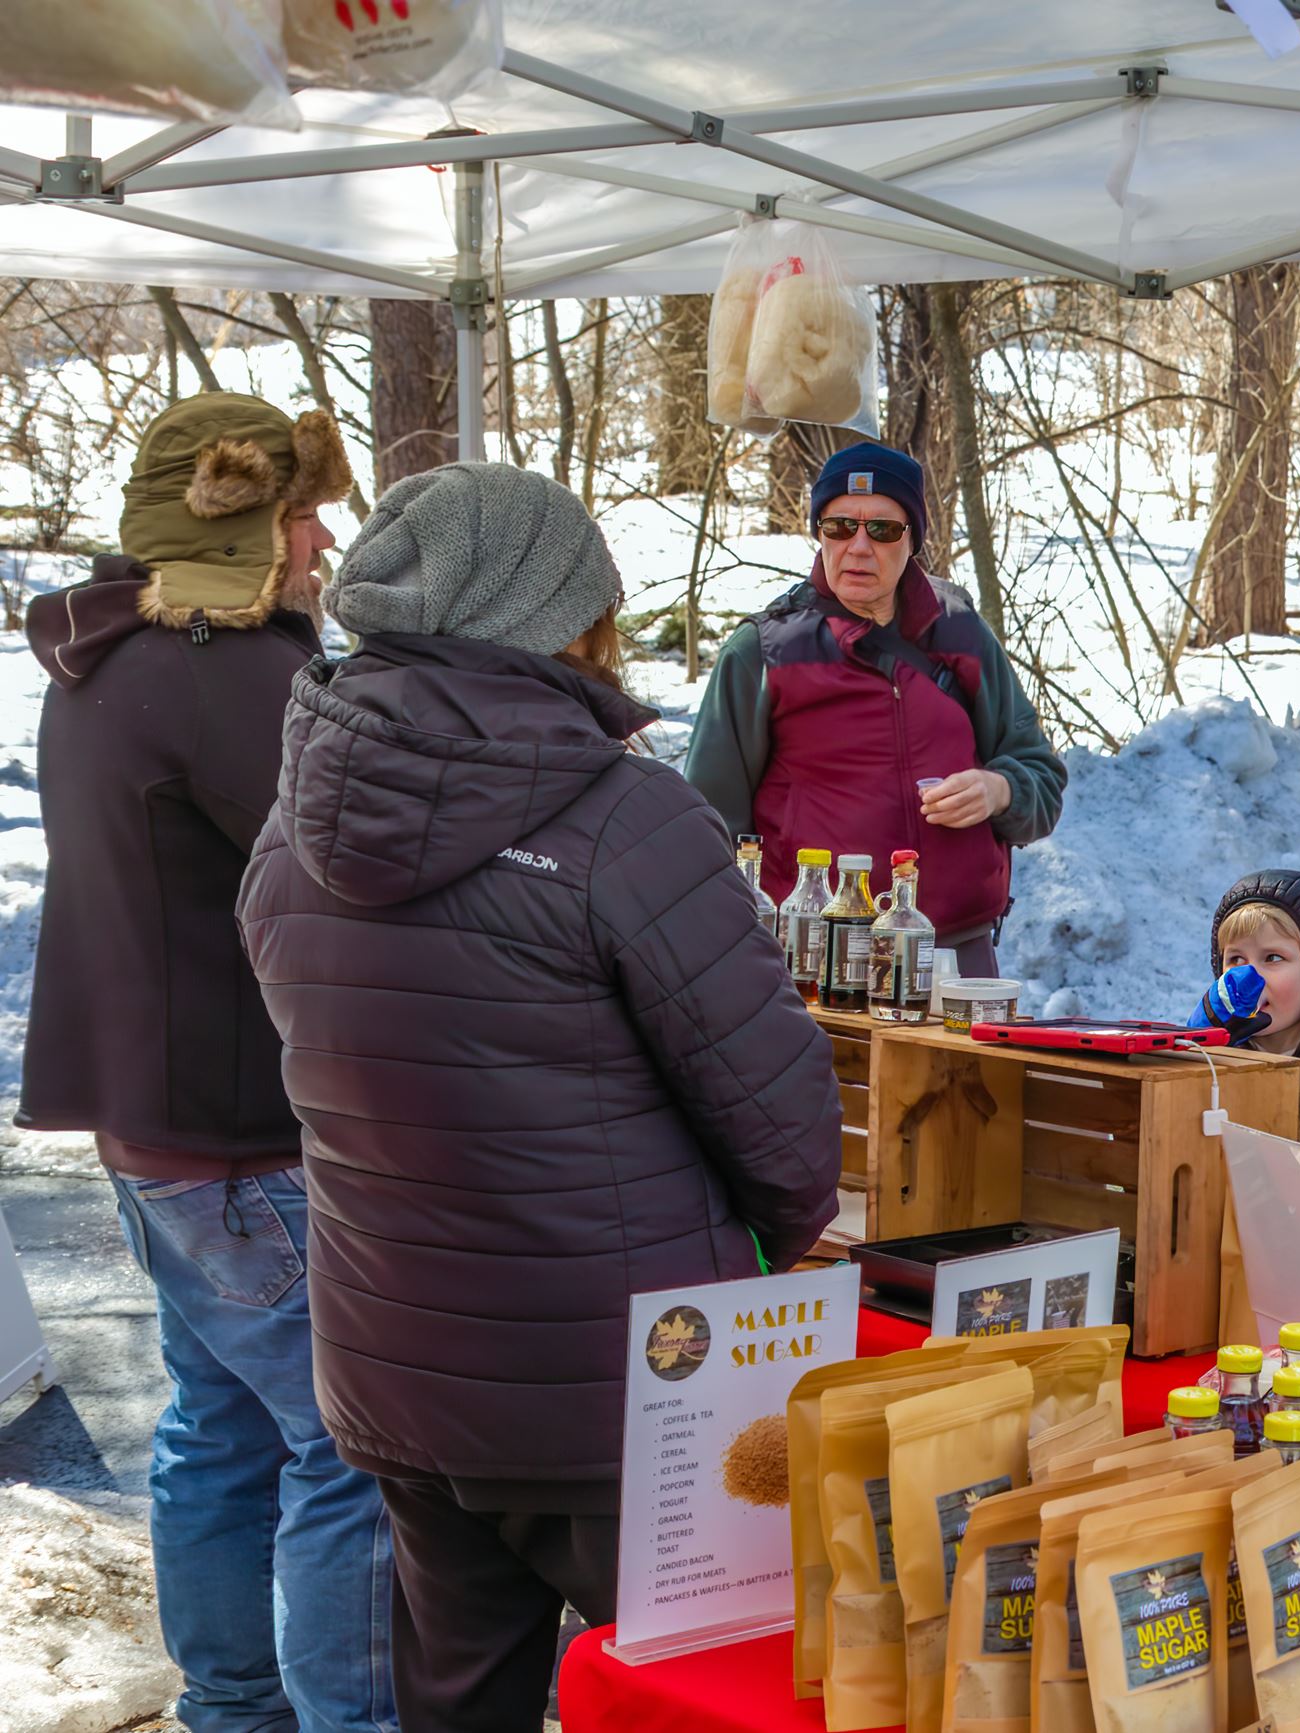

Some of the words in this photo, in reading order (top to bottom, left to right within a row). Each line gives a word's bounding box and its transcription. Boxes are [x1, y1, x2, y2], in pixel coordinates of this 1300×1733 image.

[498, 848, 558, 872] ARBON
[731, 1298, 830, 1334] MAPLE
[730, 1334, 822, 1368] SUGAR
[643, 1401, 666, 1412] GREAT
[662, 1414, 689, 1426] COFFEE
[691, 1412, 697, 1421] &
[700, 1410, 714, 1419] TEA
[661, 1430, 696, 1442] OATMEAL
[661, 1448, 687, 1459] CEREAL
[660, 1467, 671, 1475] ICE
[673, 1462, 699, 1473] CREAM
[660, 1480, 695, 1492] POPCORN
[659, 1496, 688, 1508] YOGURT
[658, 1512, 693, 1525] GRANOLA
[657, 1528, 695, 1542] BUTTERED
[656, 1544, 680, 1556] TOAST
[656, 1559, 688, 1573] CANDIED
[689, 1554, 714, 1566] BACON
[655, 1580, 670, 1589] DRY
[671, 1577, 686, 1586] RUB
[687, 1573, 701, 1583] FOR
[703, 1567, 727, 1579] MEATS
[654, 1590, 691, 1606] PANCAKES
[692, 1589, 697, 1598] &
[746, 1571, 771, 1586] BATTER
[772, 1571, 783, 1580] OR
[783, 1569, 790, 1578] A
[1136, 1607, 1204, 1647] MAPLE
[1139, 1630, 1208, 1669] SUGAR
